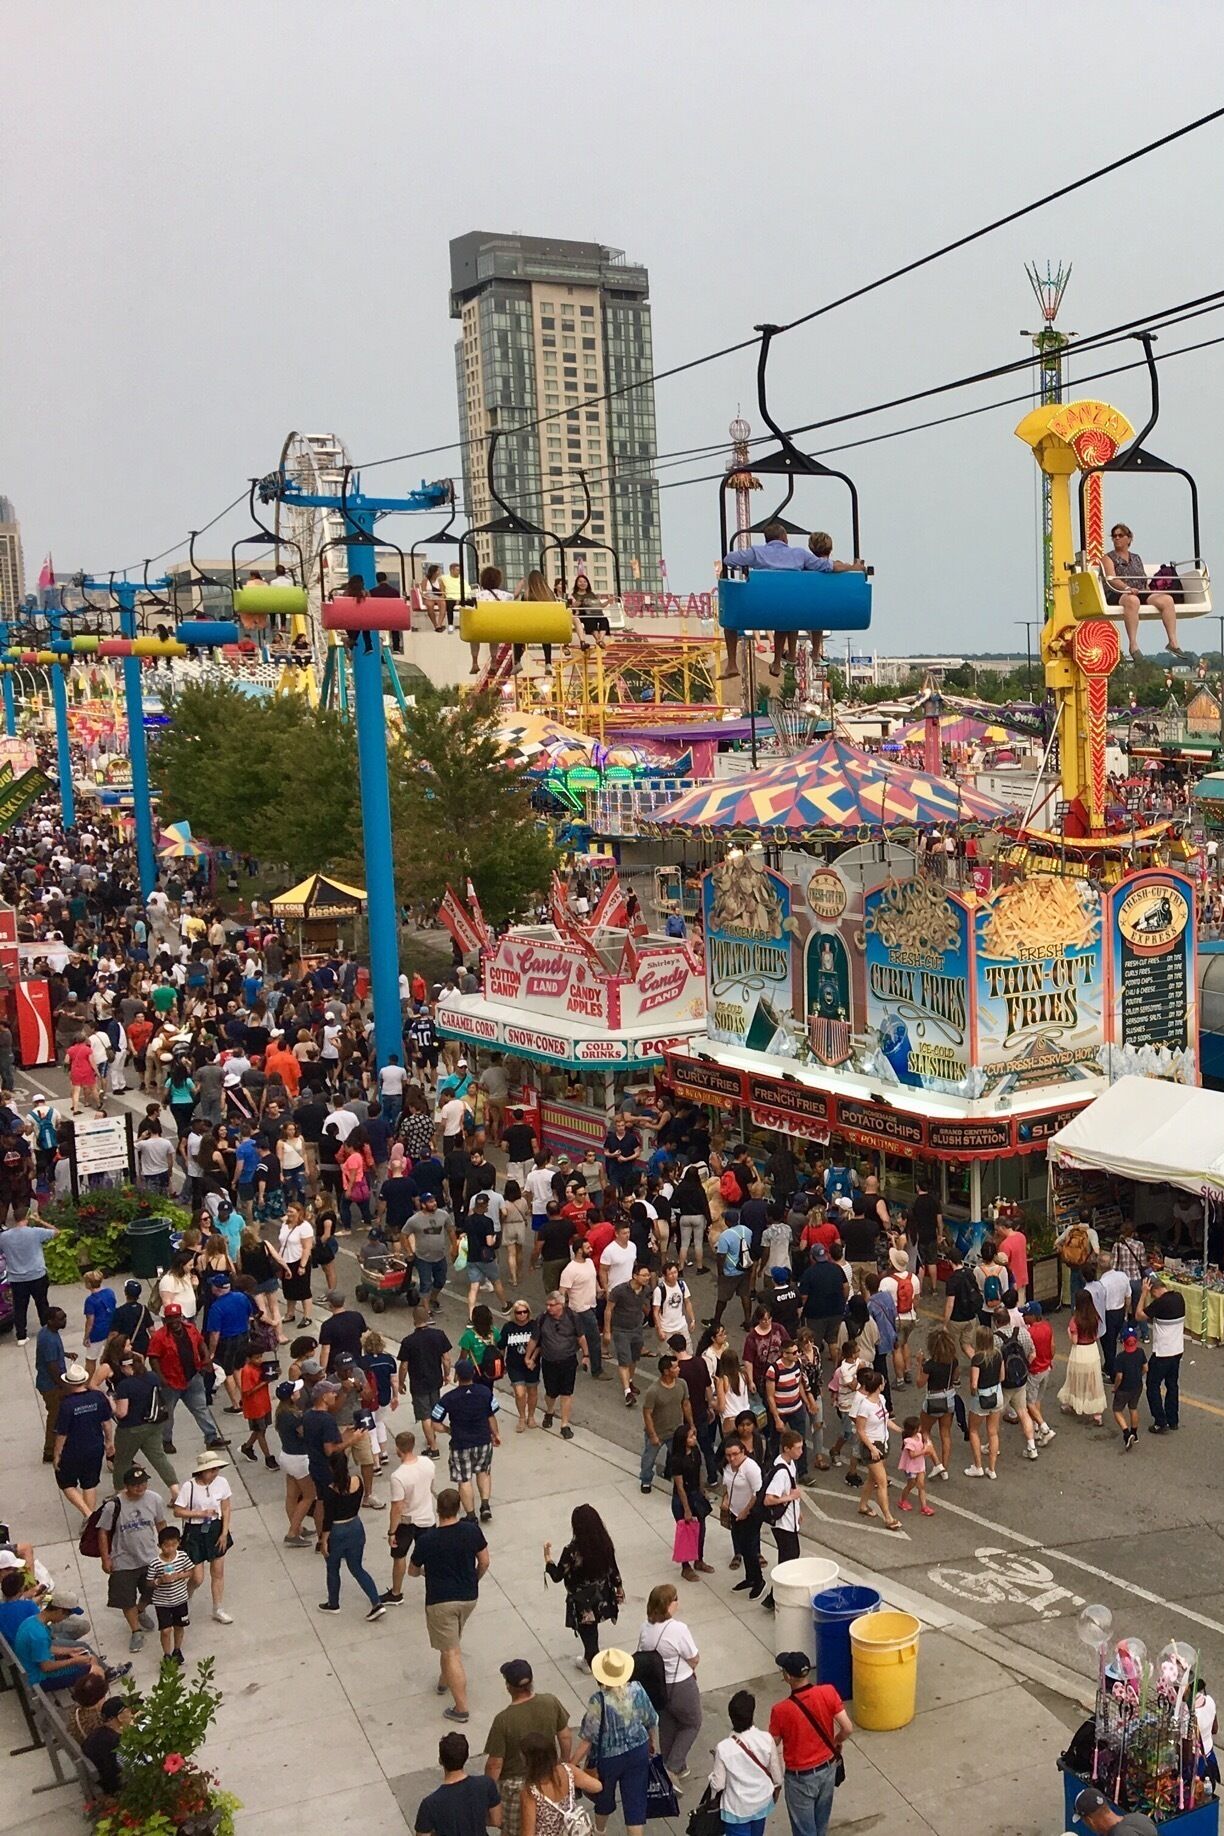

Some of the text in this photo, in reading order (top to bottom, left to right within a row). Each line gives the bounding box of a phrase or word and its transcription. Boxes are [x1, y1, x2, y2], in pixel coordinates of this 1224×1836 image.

[1055, 404, 1128, 437] BANZAI
[0, 791, 27, 825] ICKLE
[1122, 887, 1185, 914] FRESH-CUT FRY
[722, 924, 772, 941] HOMEMADE
[1131, 927, 1177, 944] EXPRESS
[516, 947, 573, 976] Candy
[709, 937, 787, 985] POTATO CHIPS
[889, 949, 945, 971] FRESH-CUT
[1019, 943, 1064, 961] FRESH
[490, 966, 521, 985] COTTON
[639, 966, 689, 993] Candy
[985, 954, 1096, 998] THIN-CUT
[491, 981, 519, 998] CANDY
[533, 980, 558, 992] LAND
[570, 984, 601, 1002] CANDY
[646, 987, 679, 1008] LAND
[870, 963, 966, 1031] CURLY FRIES
[567, 998, 603, 1017] APPLES
[1005, 987, 1078, 1037] FRIES
[441, 1012, 495, 1037] CARAMEL CORN
[714, 1012, 745, 1033] SODAS
[417, 1031, 431, 1046] 10
[508, 1029, 566, 1055] SNOW-CONES
[586, 1043, 614, 1051] COLD
[582, 1050, 622, 1059] DRINKS
[919, 1042, 955, 1059] ICE-COLD
[908, 1052, 967, 1081] SLUSHIES
[676, 1069, 739, 1092] CURLY FRIES
[754, 1088, 826, 1114] FRENCH FRIES
[841, 1110, 920, 1140] POTATO CHIPS
[863, 1109, 897, 1123] HOMEMADE
[1058, 1113, 1071, 1121] ICE
[1032, 1121, 1068, 1137] SLU
[860, 1135, 900, 1152] POUTINE
[932, 1134, 1006, 1145] SLUSH STATION
[777, 1290, 796, 1302] earth
